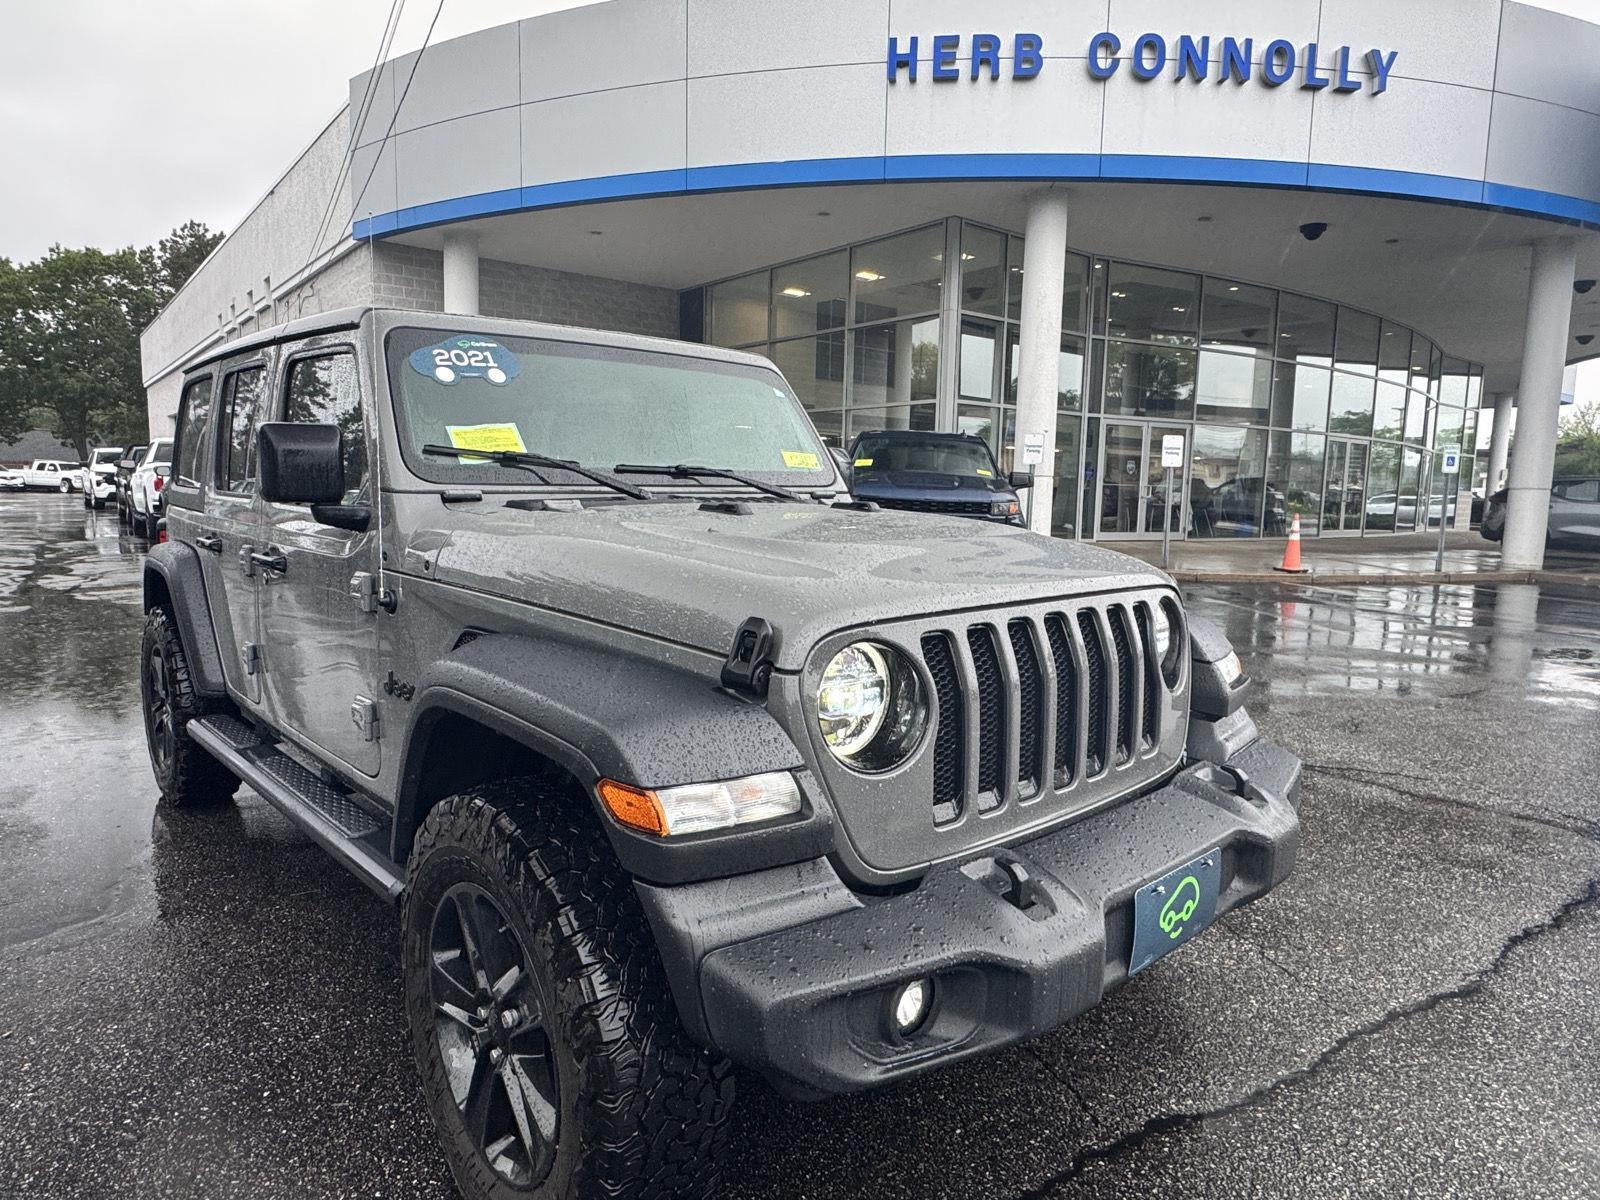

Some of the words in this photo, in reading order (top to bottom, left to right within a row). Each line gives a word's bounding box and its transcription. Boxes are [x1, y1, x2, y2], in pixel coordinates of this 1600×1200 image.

[887, 33, 1043, 83] HERB
[1088, 32, 1398, 96] CONNOLLY
[433, 348, 498, 367] 2021
